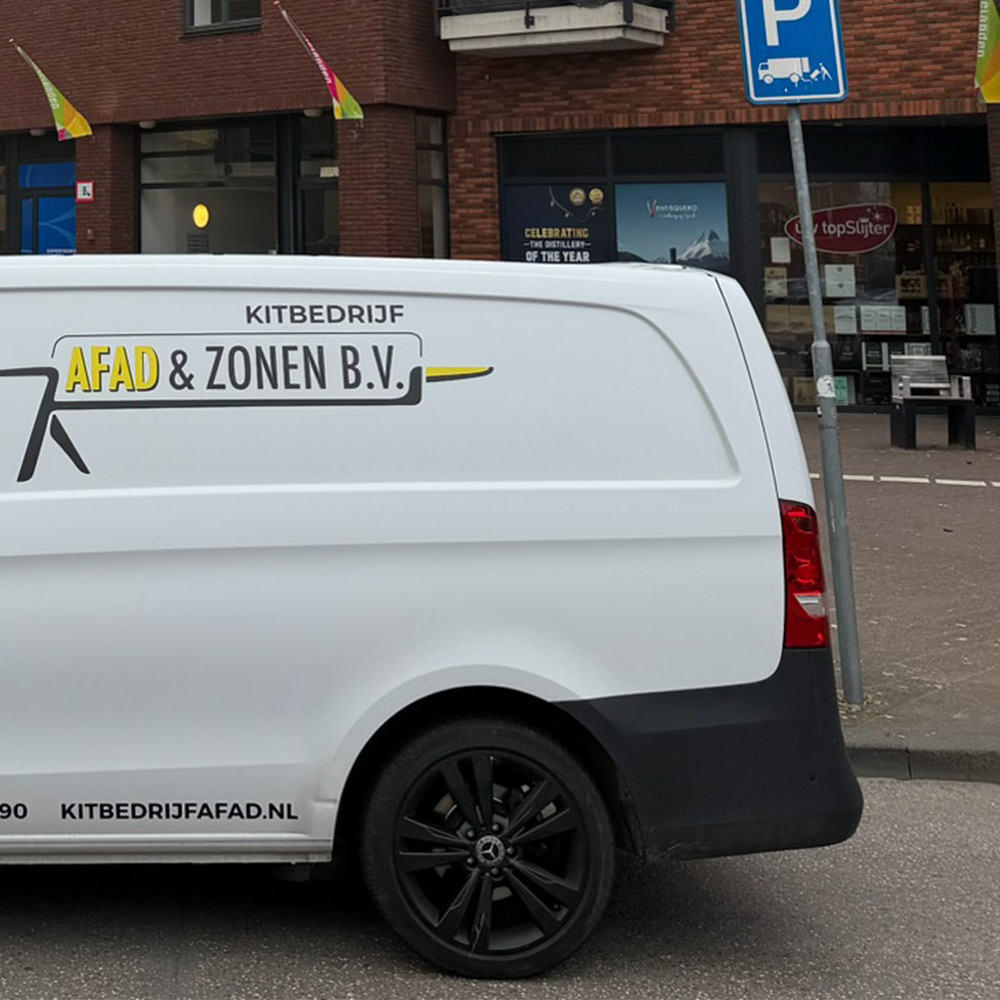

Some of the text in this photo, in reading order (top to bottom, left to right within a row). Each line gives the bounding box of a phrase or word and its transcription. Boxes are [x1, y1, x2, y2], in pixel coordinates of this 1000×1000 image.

[524, 228, 589, 238] CELEBRATING
[822, 219, 891, 238] topSlijter
[530, 240, 585, 248] THE DISTILLERY
[526, 251, 590, 262] OF THE YEAR
[245, 304, 405, 325] KITBEDRIJF
[65, 345, 405, 393] AFAD & ZONEN B.V.
[61, 802, 299, 821] KITBEDRIJFAFAD.NL
